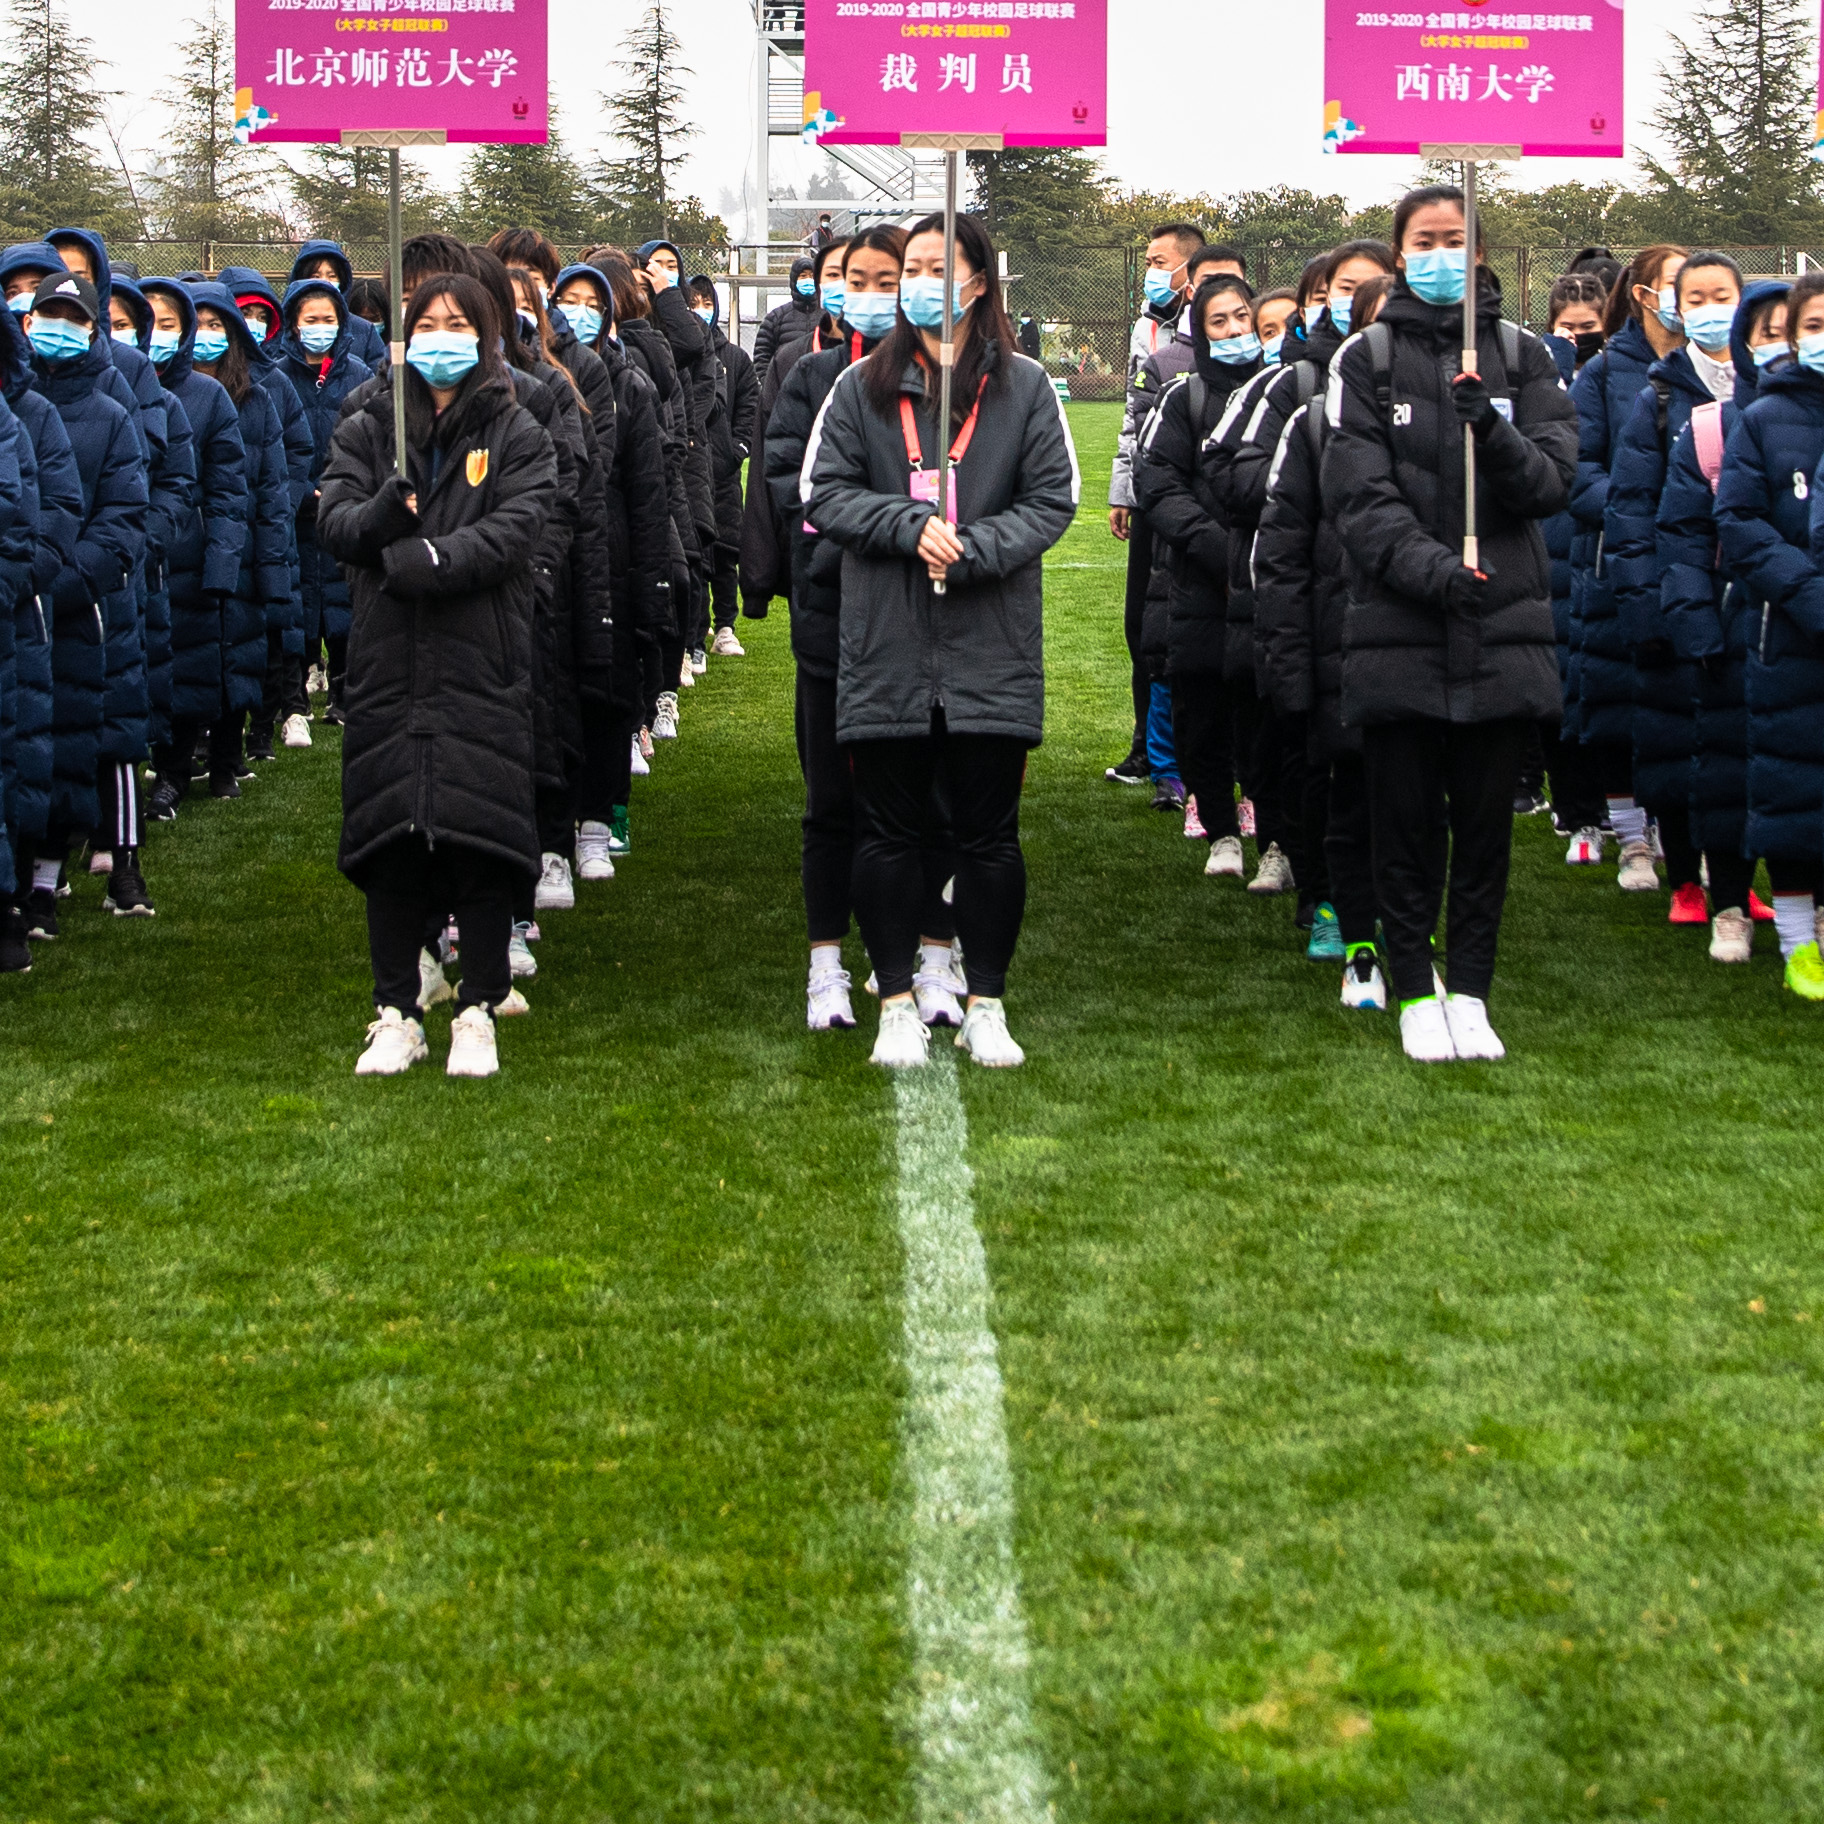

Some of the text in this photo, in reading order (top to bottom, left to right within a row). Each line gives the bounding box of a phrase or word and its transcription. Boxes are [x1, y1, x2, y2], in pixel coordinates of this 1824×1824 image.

[836, 2, 1075, 19] 2019-2020 全国青少年校园足球联赛
[1356, 13, 1593, 31] 2019-2020 全国青少年校园足球联赛
[266, 47, 518, 88] 北京师范大学
[1395, 63, 1555, 103] 西南大学
[1393, 403, 1412, 426] 20
[1792, 471, 1808, 499] 8
